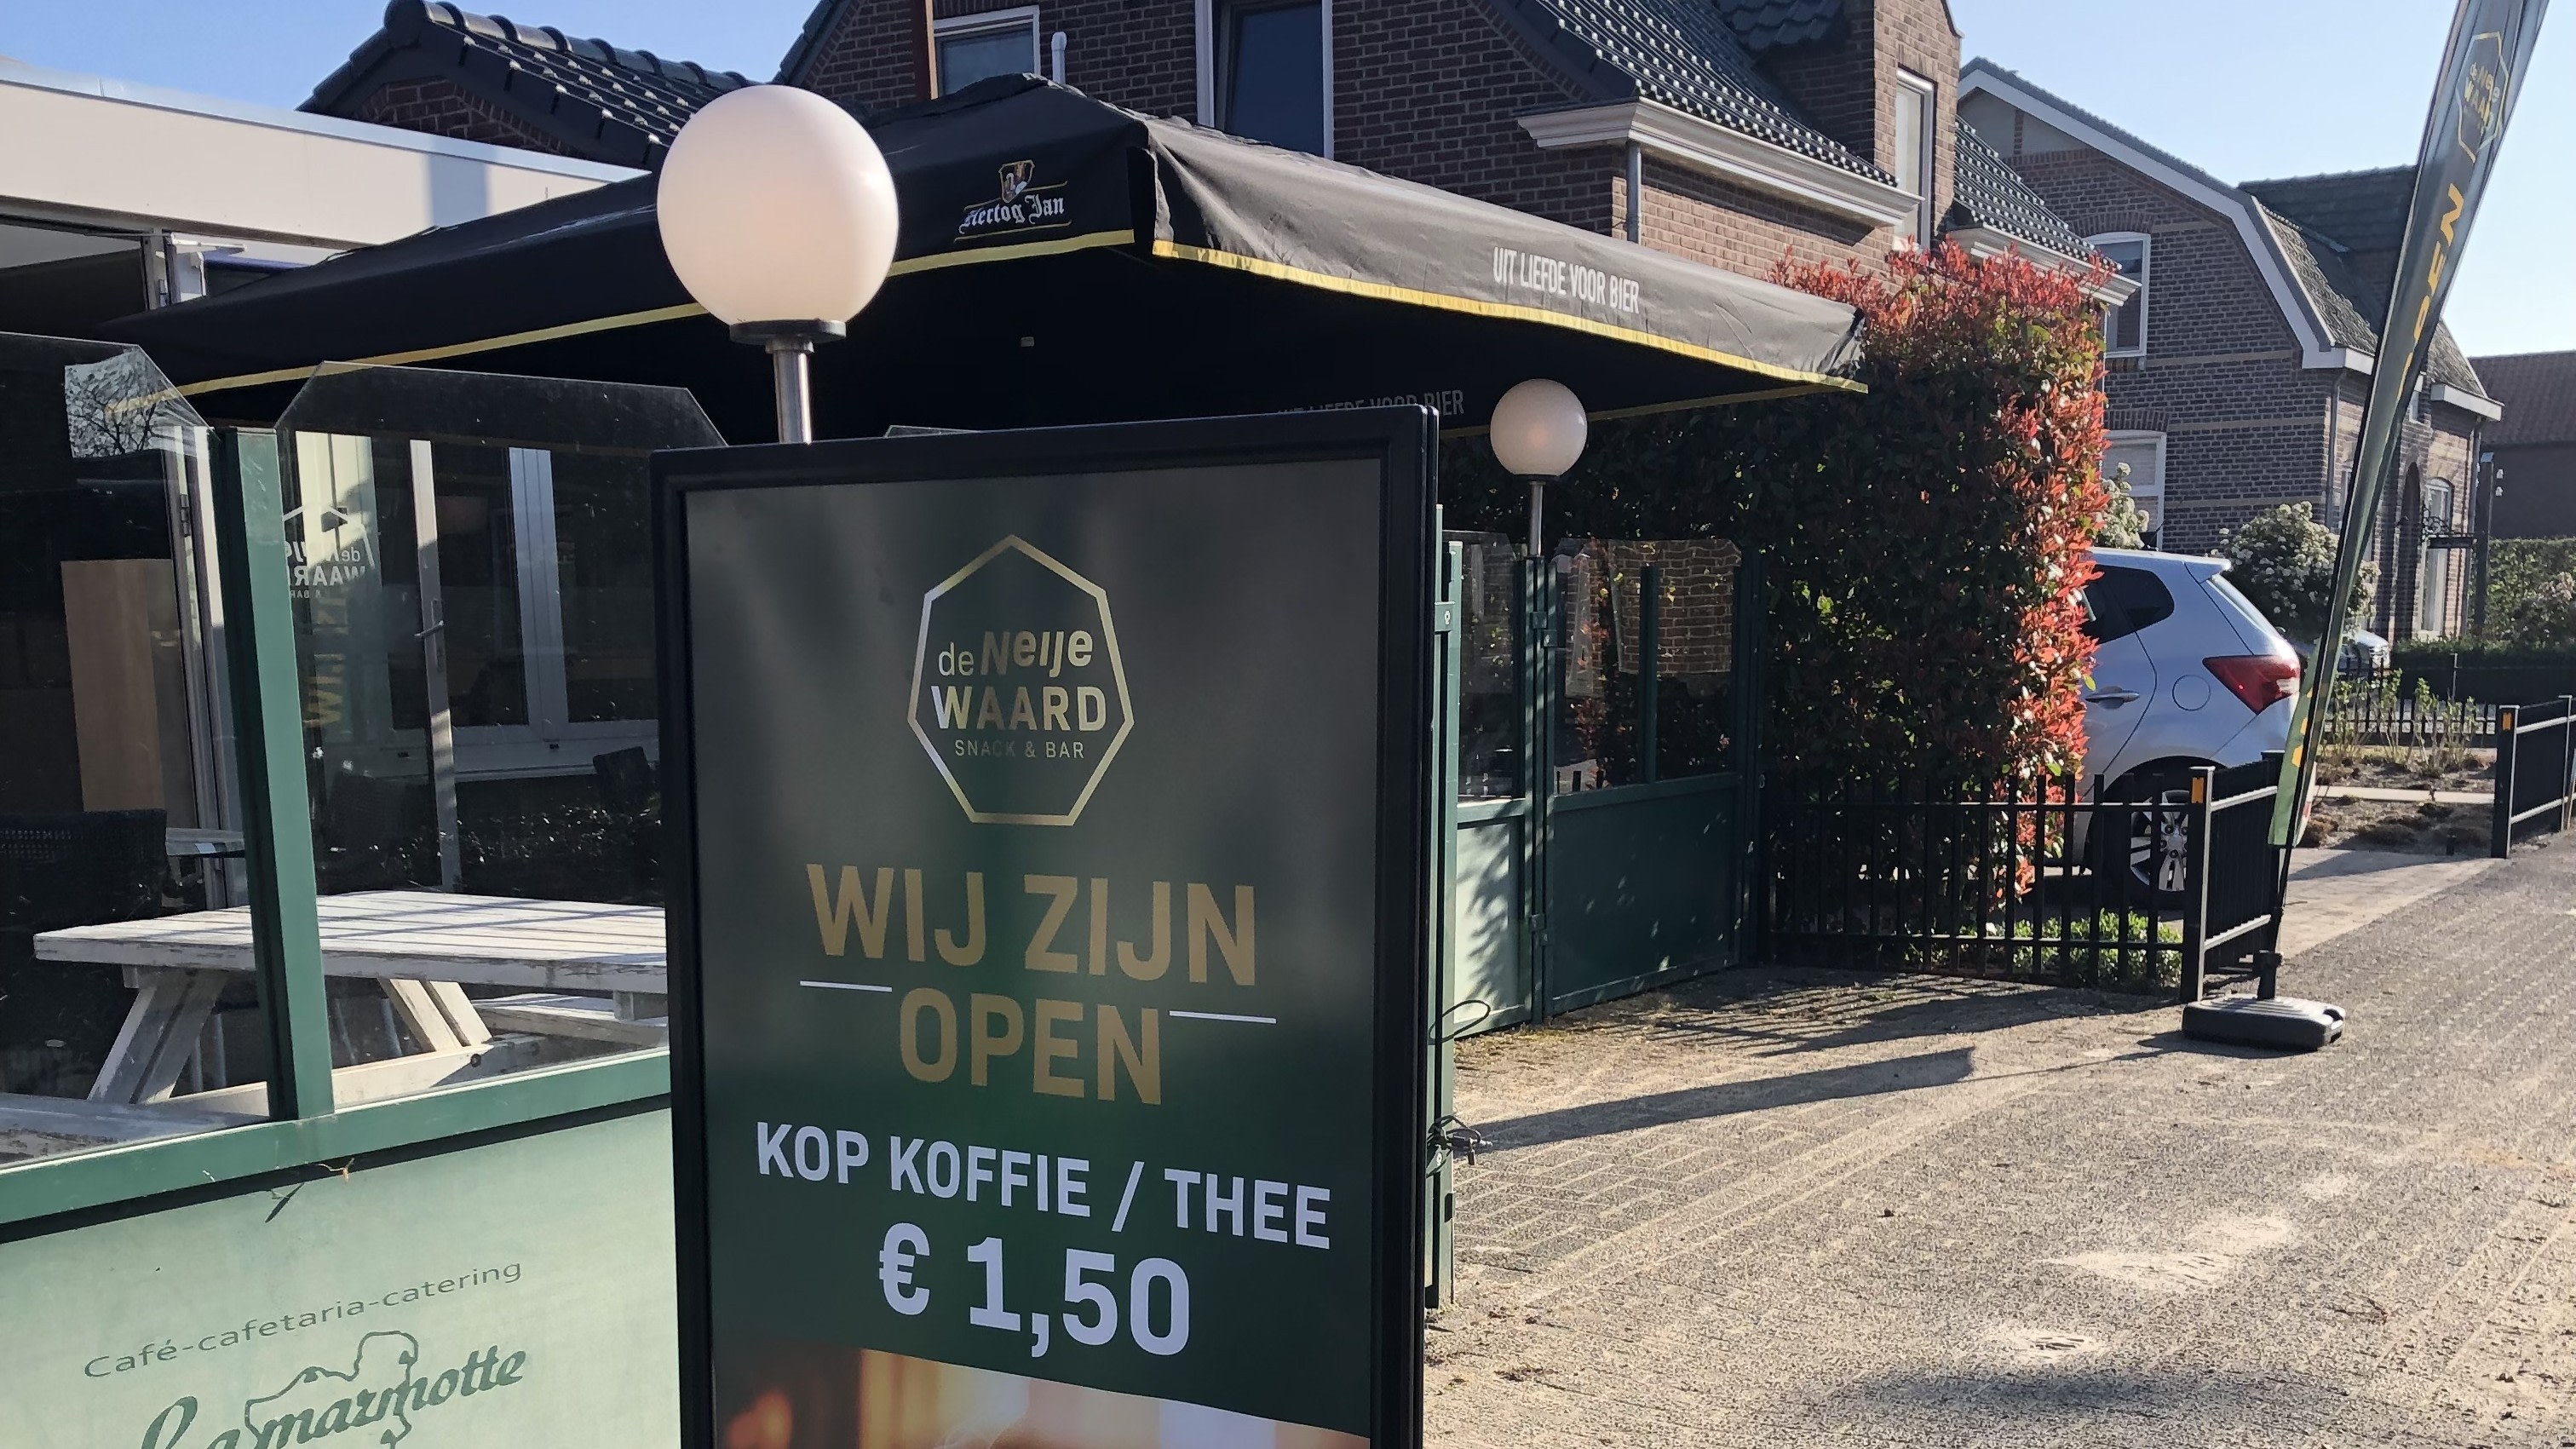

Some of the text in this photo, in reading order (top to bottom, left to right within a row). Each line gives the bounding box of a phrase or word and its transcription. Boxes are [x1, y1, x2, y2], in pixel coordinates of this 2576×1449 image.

[958, 193, 1065, 234] Hertog Jan
[1493, 246, 1641, 314] UIT LIEFDE VOOR BIER
[938, 630, 1094, 678] de Neije
[930, 685, 1107, 732] WAARD
[955, 739, 1084, 759] SNACK & BAR
[806, 864, 1256, 986] WIJ ZIJN
[900, 987, 1162, 1106] OPEN
[756, 1121, 1331, 1250] KOP KOFFIE / THEE
[878, 1222, 1191, 1359] € 1,50
